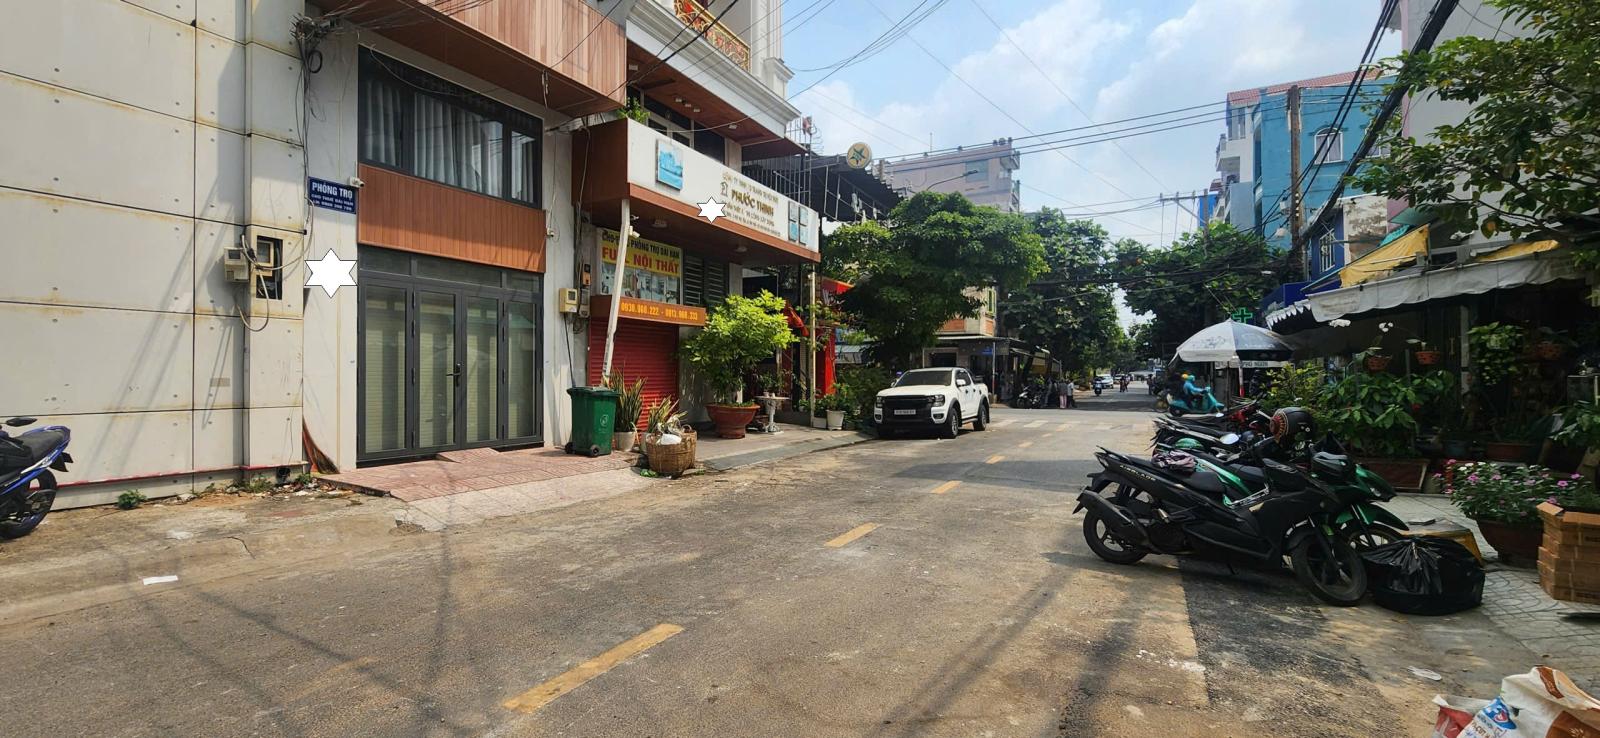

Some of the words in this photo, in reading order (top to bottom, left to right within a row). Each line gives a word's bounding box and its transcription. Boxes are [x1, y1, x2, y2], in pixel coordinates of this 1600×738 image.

[312, 181, 337, 196] PHÒNG
[339, 187, 353, 200] TRỌ
[731, 188, 756, 209] PHƯỚC
[633, 252, 652, 269] NỘI
[656, 258, 679, 274] THẤT
